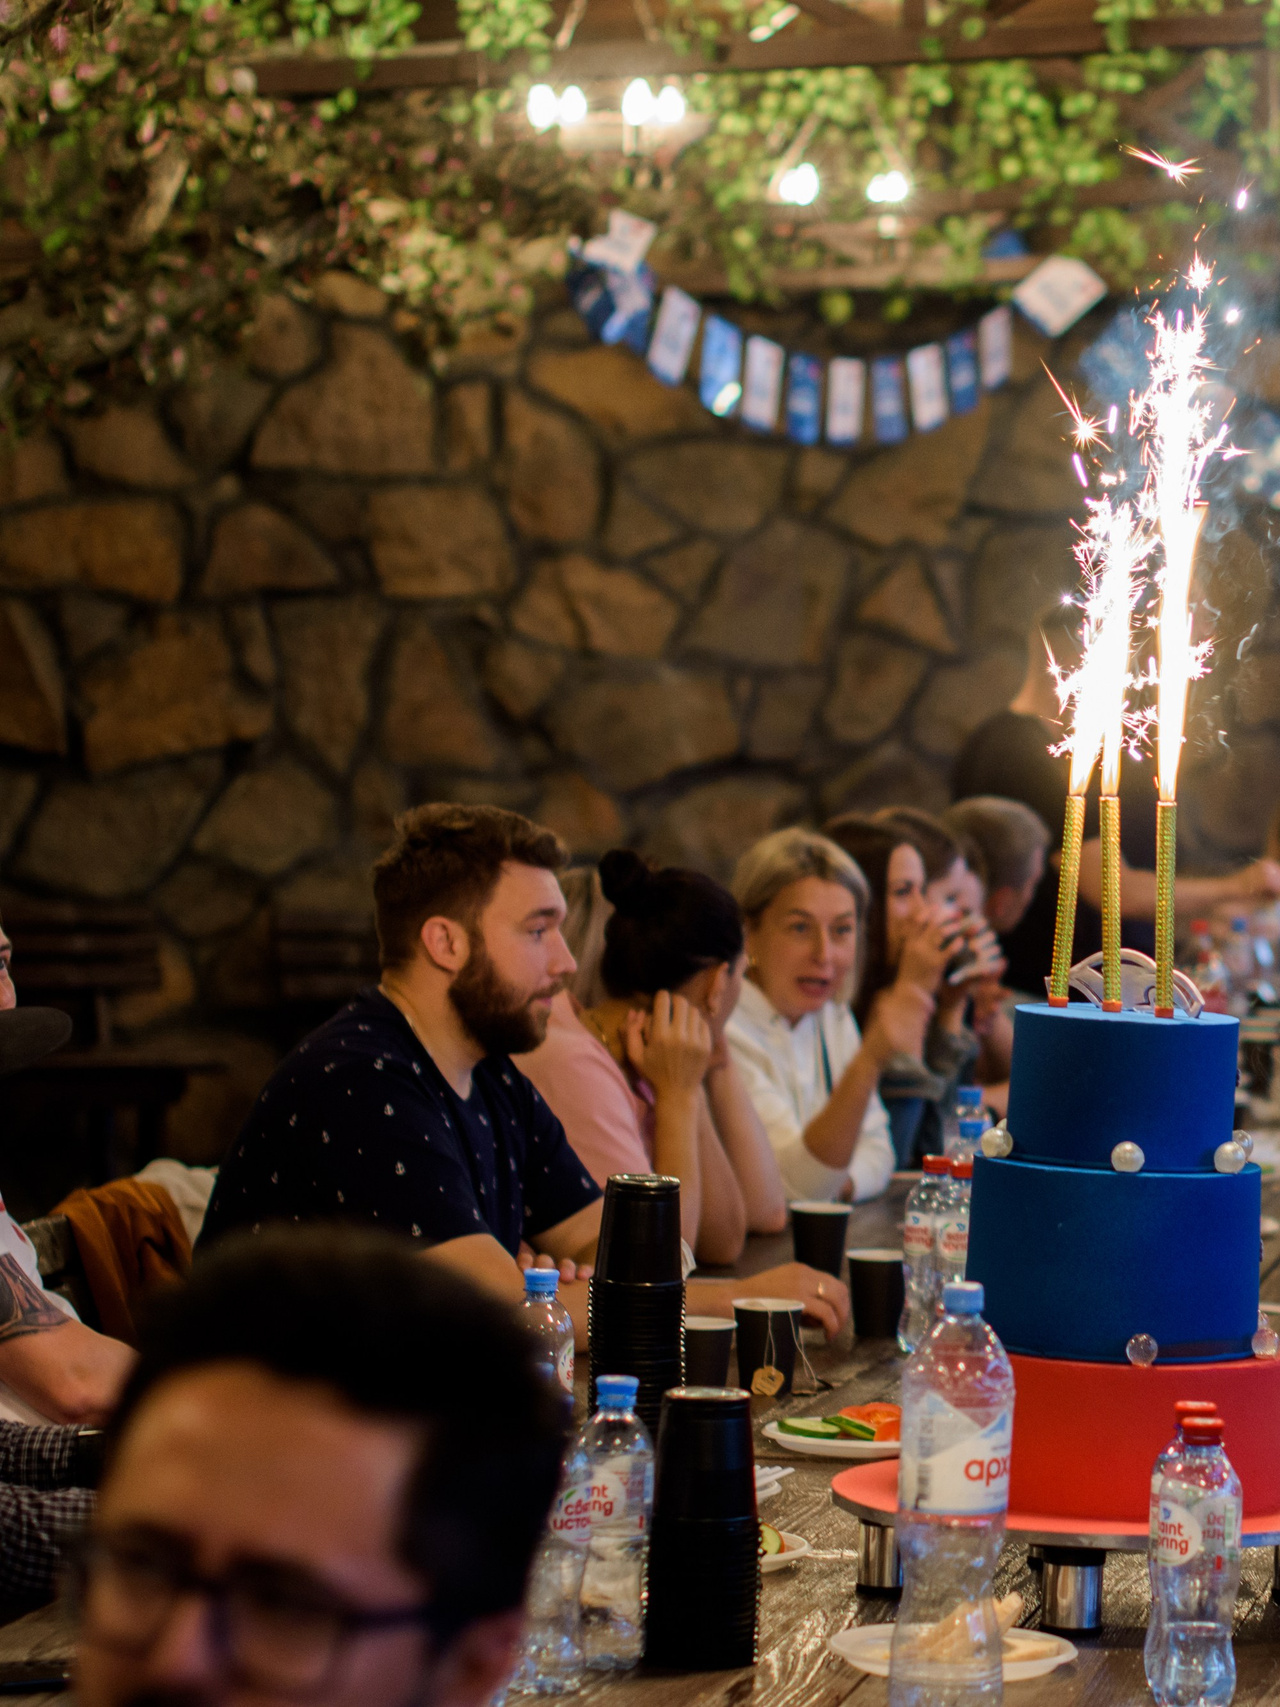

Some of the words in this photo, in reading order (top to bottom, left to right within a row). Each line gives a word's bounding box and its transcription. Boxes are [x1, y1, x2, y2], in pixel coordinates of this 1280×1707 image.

[963, 1456, 1009, 1488] арх
[1158, 1520, 1184, 1537] aint
[1157, 1535, 1189, 1556] ring
